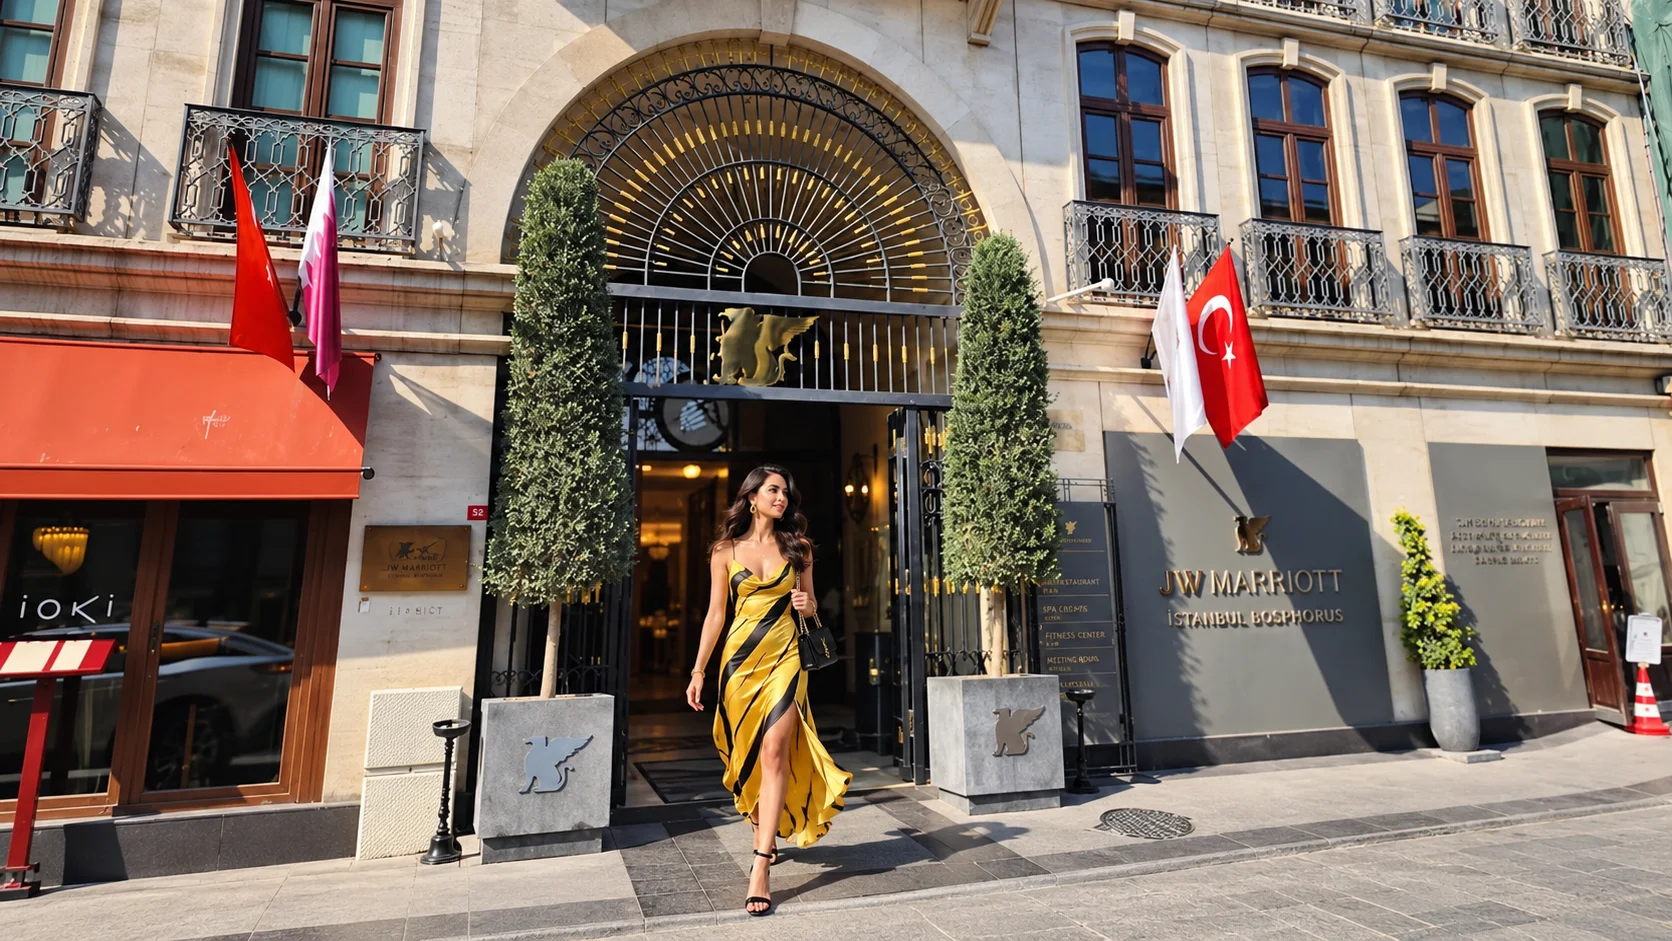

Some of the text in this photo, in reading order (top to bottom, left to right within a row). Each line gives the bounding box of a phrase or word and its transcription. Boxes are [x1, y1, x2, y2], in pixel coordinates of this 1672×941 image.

[1159, 570, 1342, 596] JW MARRIOTT
[1042, 605, 1057, 613] SPA
[1251, 608, 1344, 625] BOSPHORUS
[1077, 631, 1106, 639] CENTER
